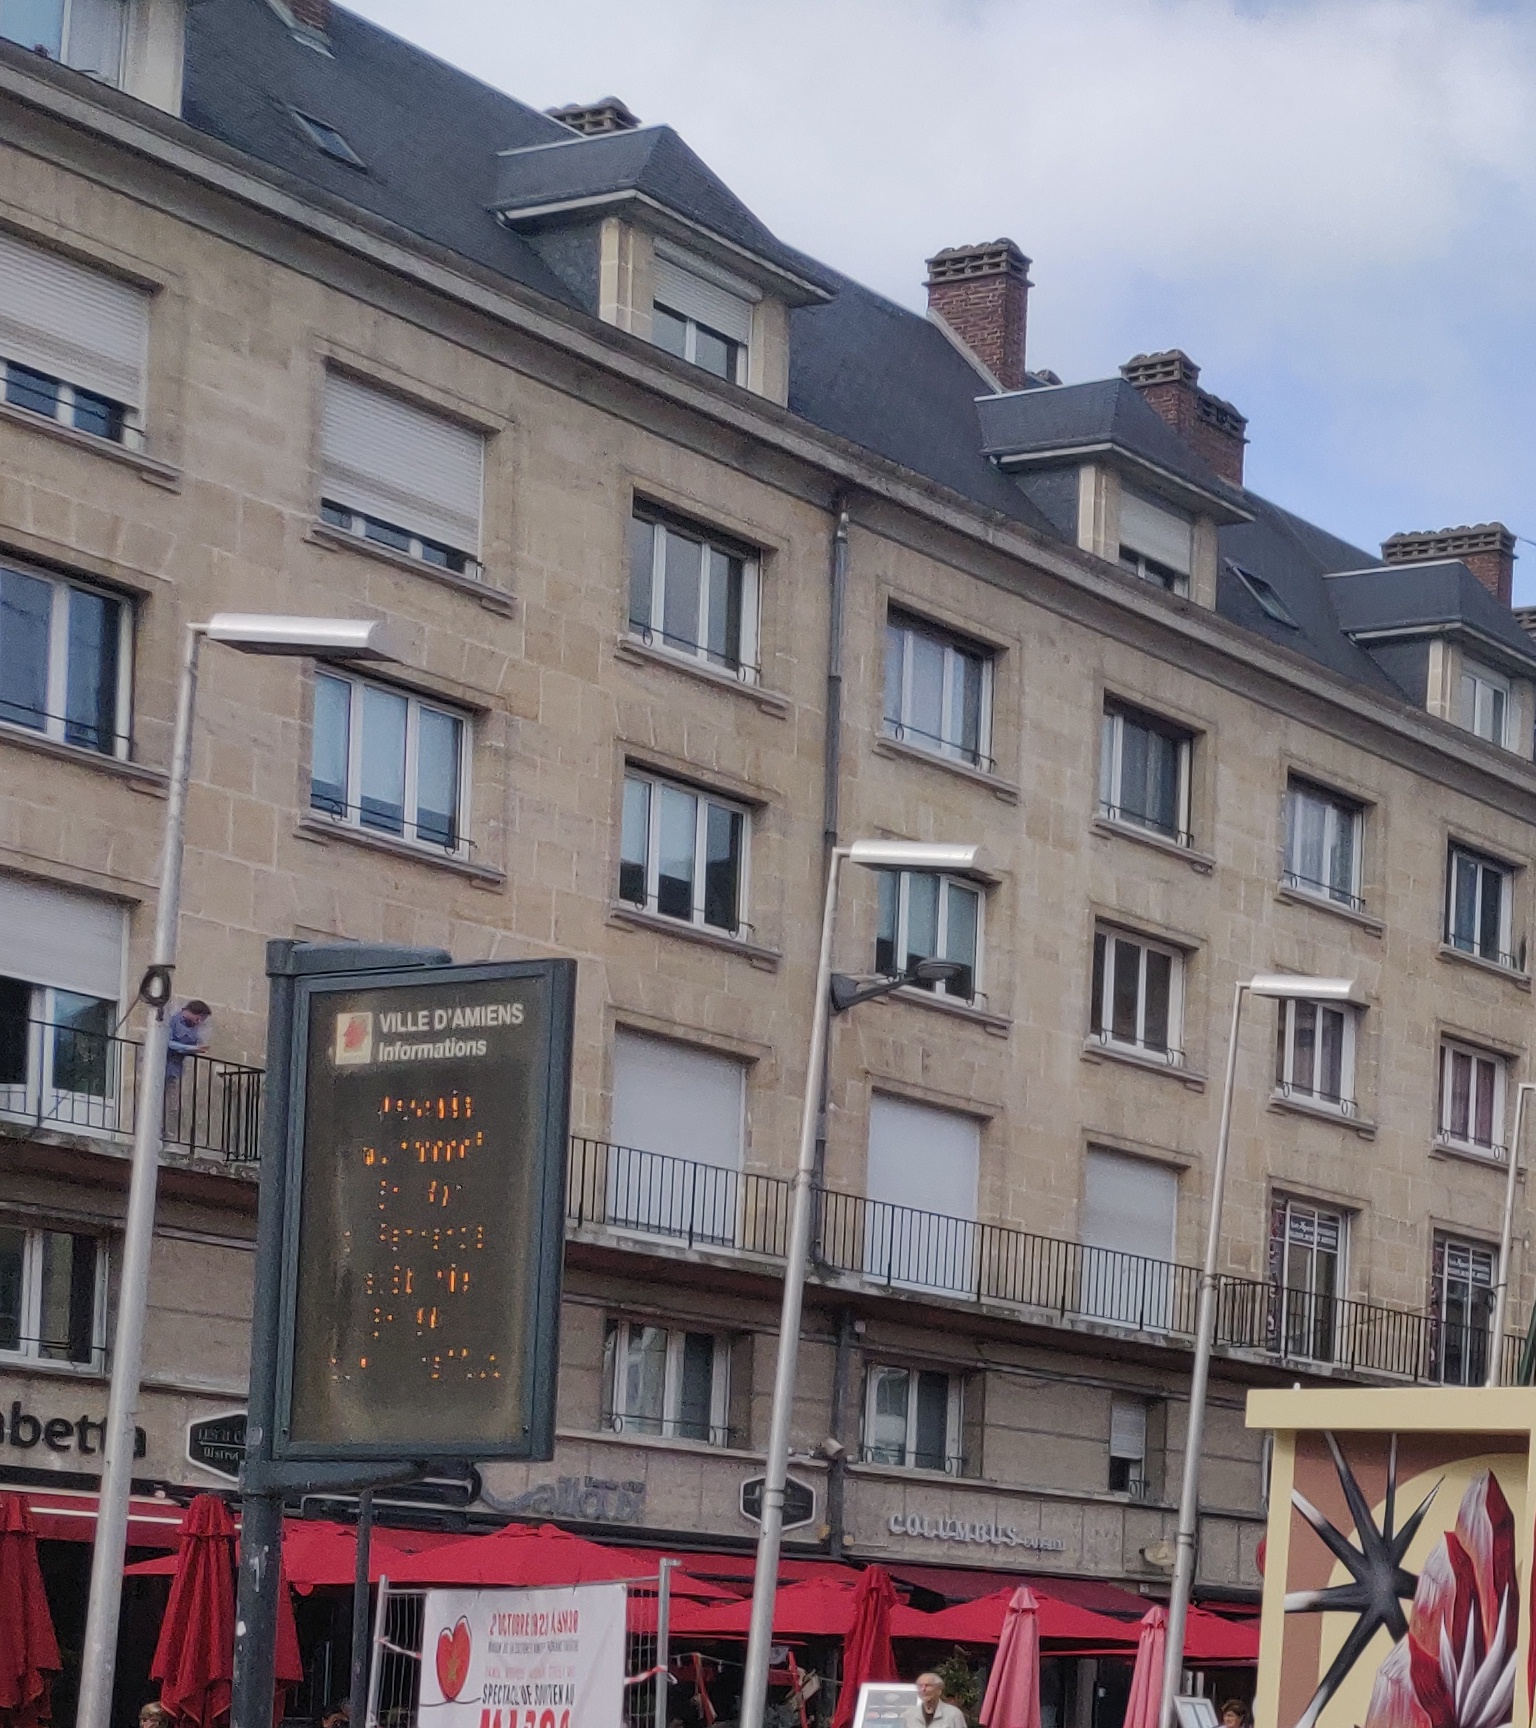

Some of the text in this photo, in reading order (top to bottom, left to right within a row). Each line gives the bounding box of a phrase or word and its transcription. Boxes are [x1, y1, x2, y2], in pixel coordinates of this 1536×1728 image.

[379, 1002, 525, 1034] VILLE D'AMIENS
[378, 1038, 487, 1062] Informations
[888, 1512, 1019, 1547] COLUMBUS
